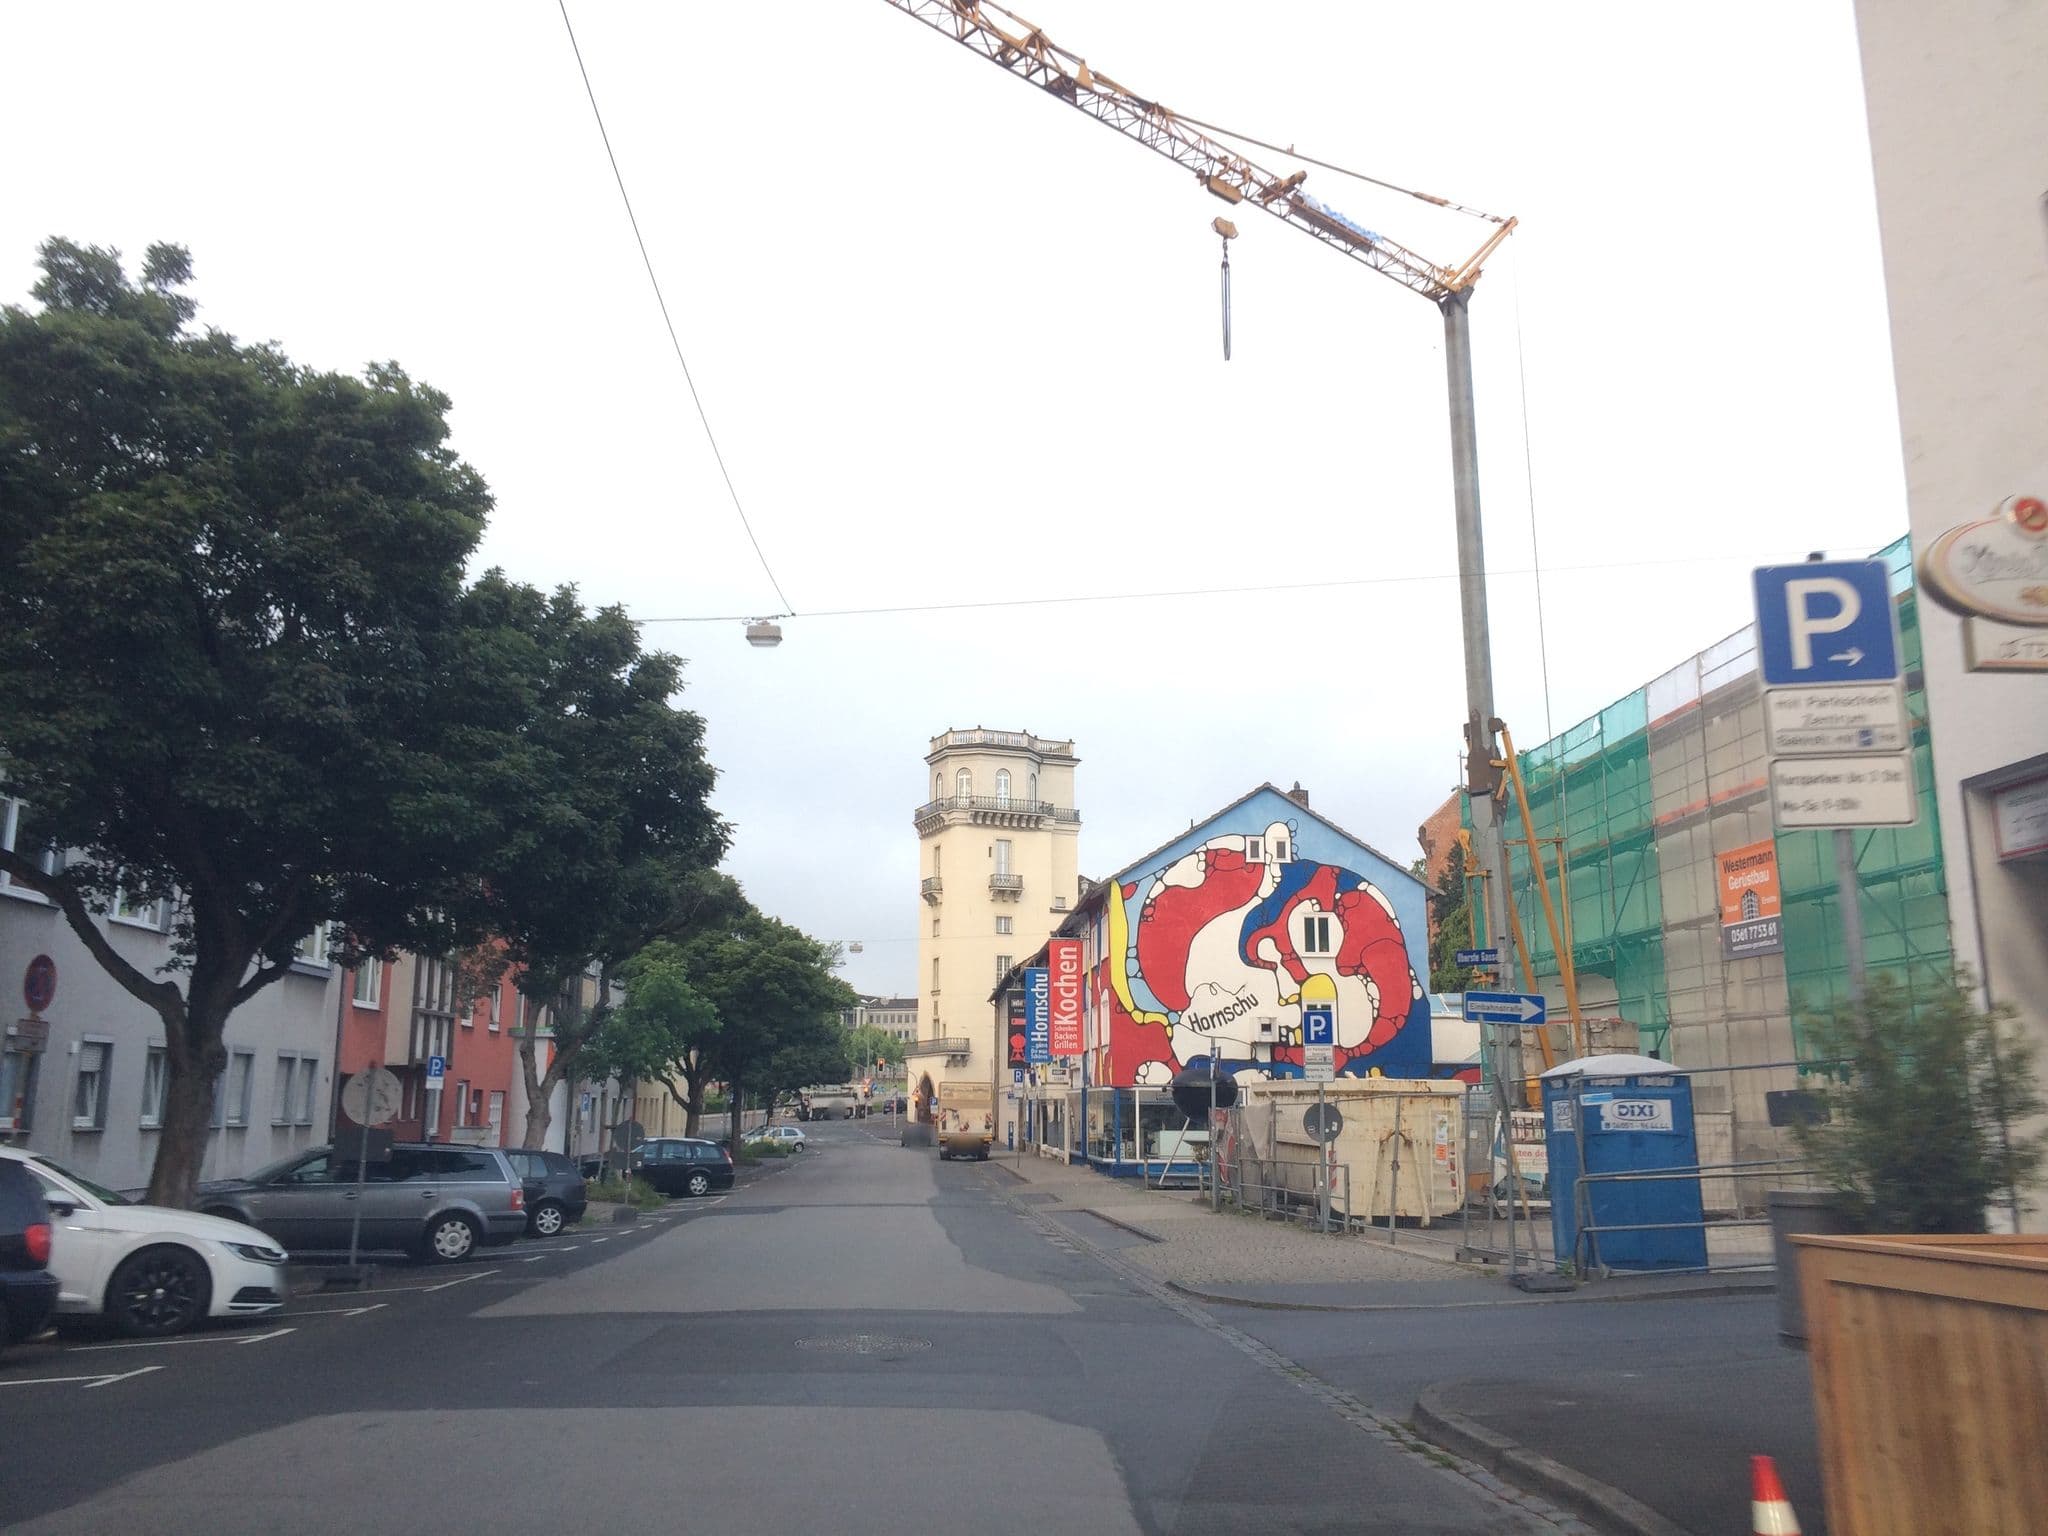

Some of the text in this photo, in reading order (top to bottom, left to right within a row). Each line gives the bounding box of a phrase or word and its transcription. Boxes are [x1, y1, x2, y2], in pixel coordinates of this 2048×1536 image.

[1785, 577, 1861, 670] P
[1723, 850, 1774, 874] Westermann
[1727, 869, 1770, 890] Gerüstbau
[1053, 946, 1078, 1025] Kochen
[1030, 973, 1049, 1042] Hornschu
[1187, 993, 1259, 1032] Hornschu
[1054, 1032, 1078, 1041] Backen
[1309, 1015, 1327, 1041] P
[1054, 1040, 1078, 1049] Grillen
